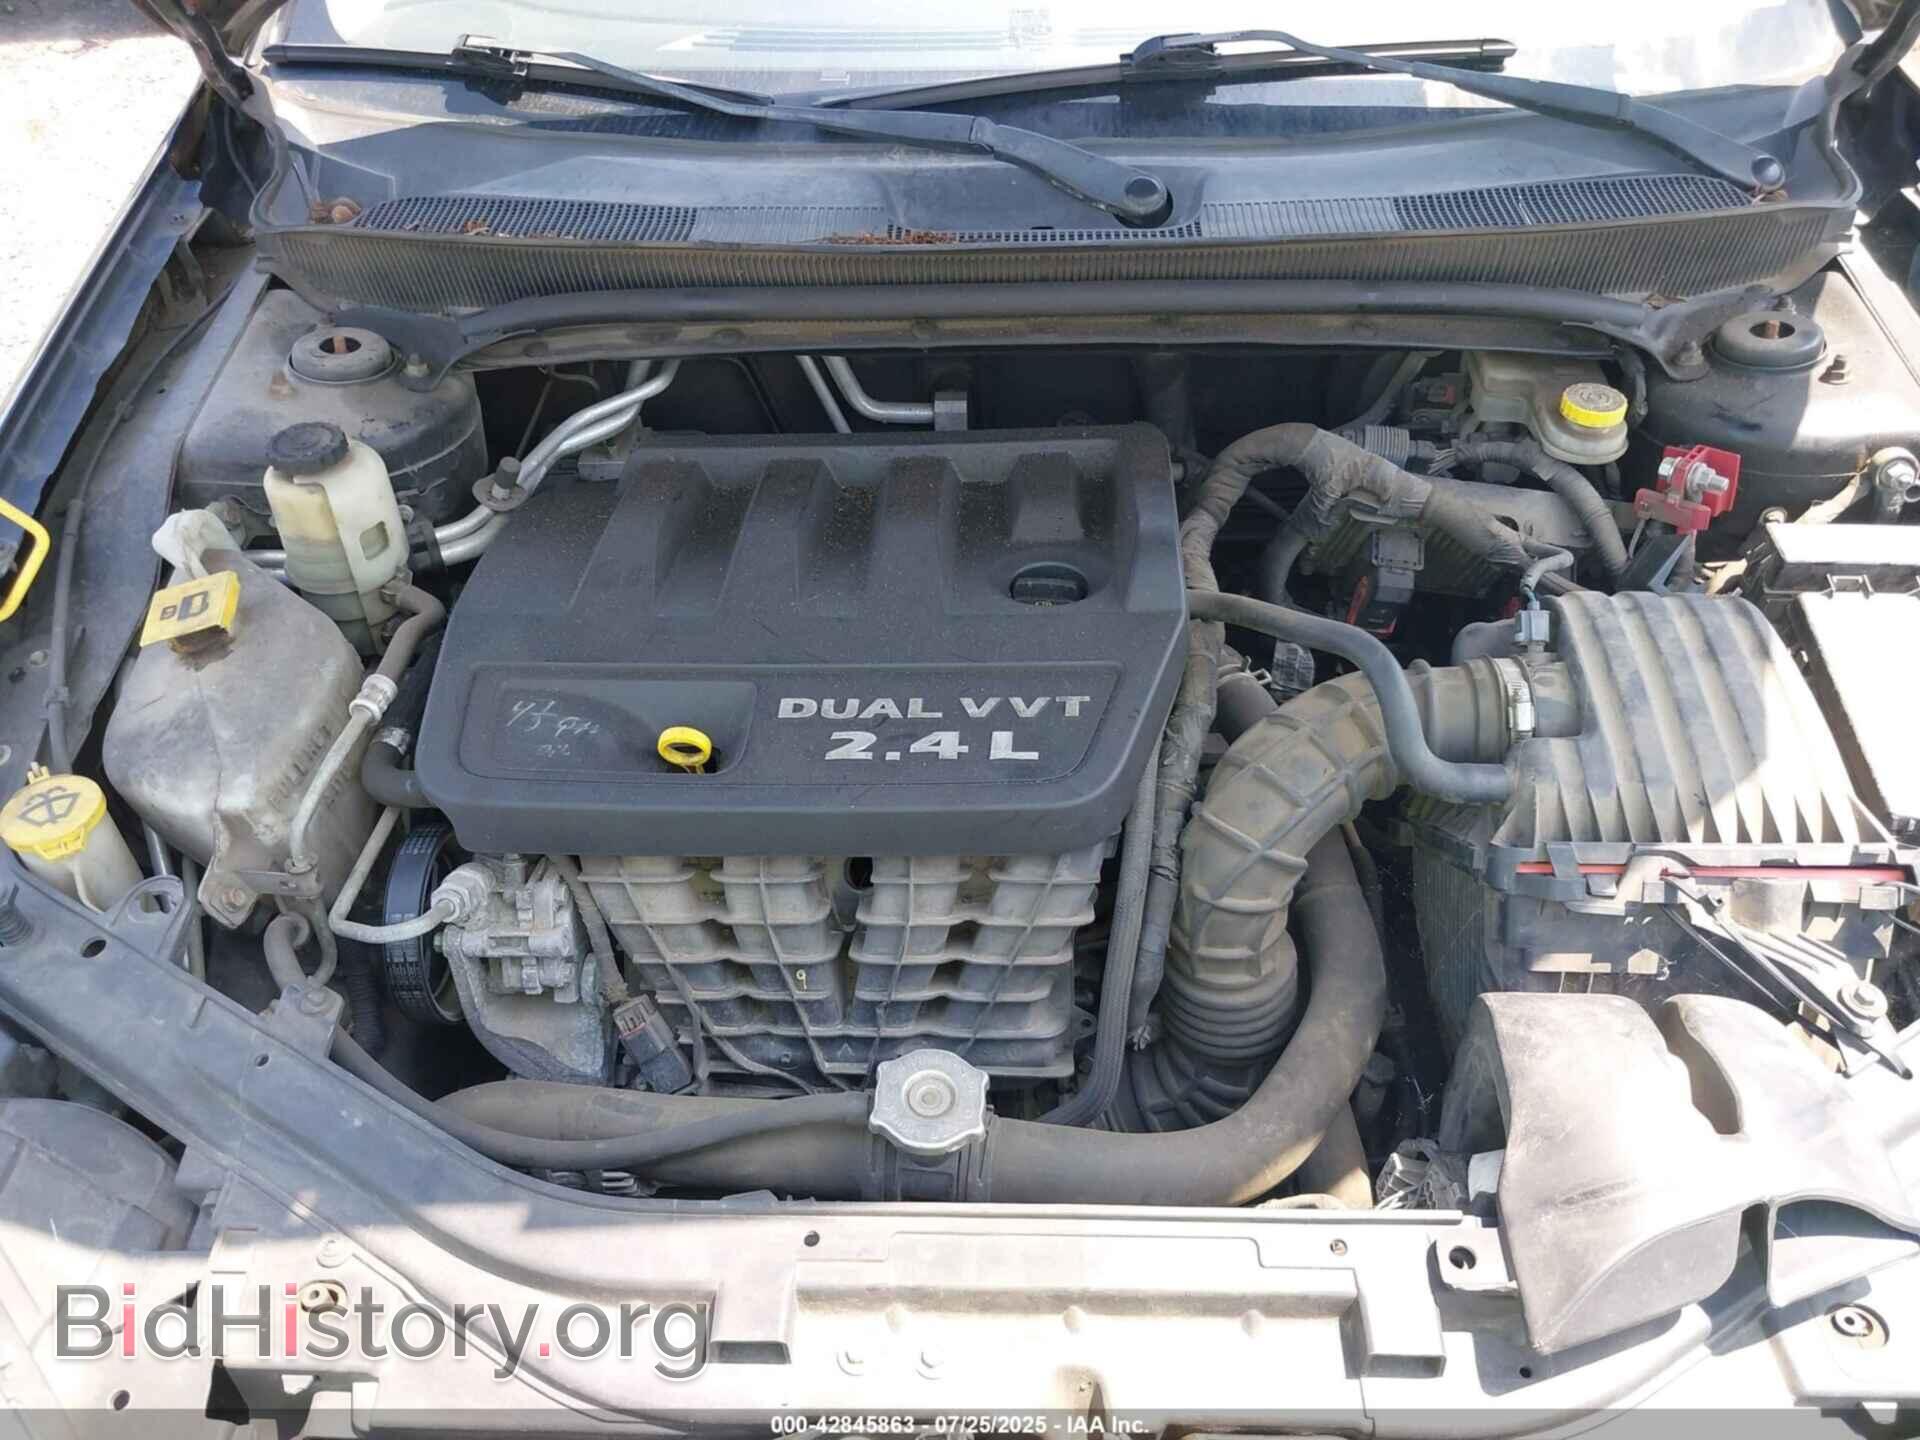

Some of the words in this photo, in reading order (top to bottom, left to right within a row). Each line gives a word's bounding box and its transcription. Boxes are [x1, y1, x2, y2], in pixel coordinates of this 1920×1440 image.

[777, 697, 943, 719] DUAL
[960, 695, 1091, 718] VVT
[825, 731, 969, 760] 2.4
[989, 731, 1039, 760] L
